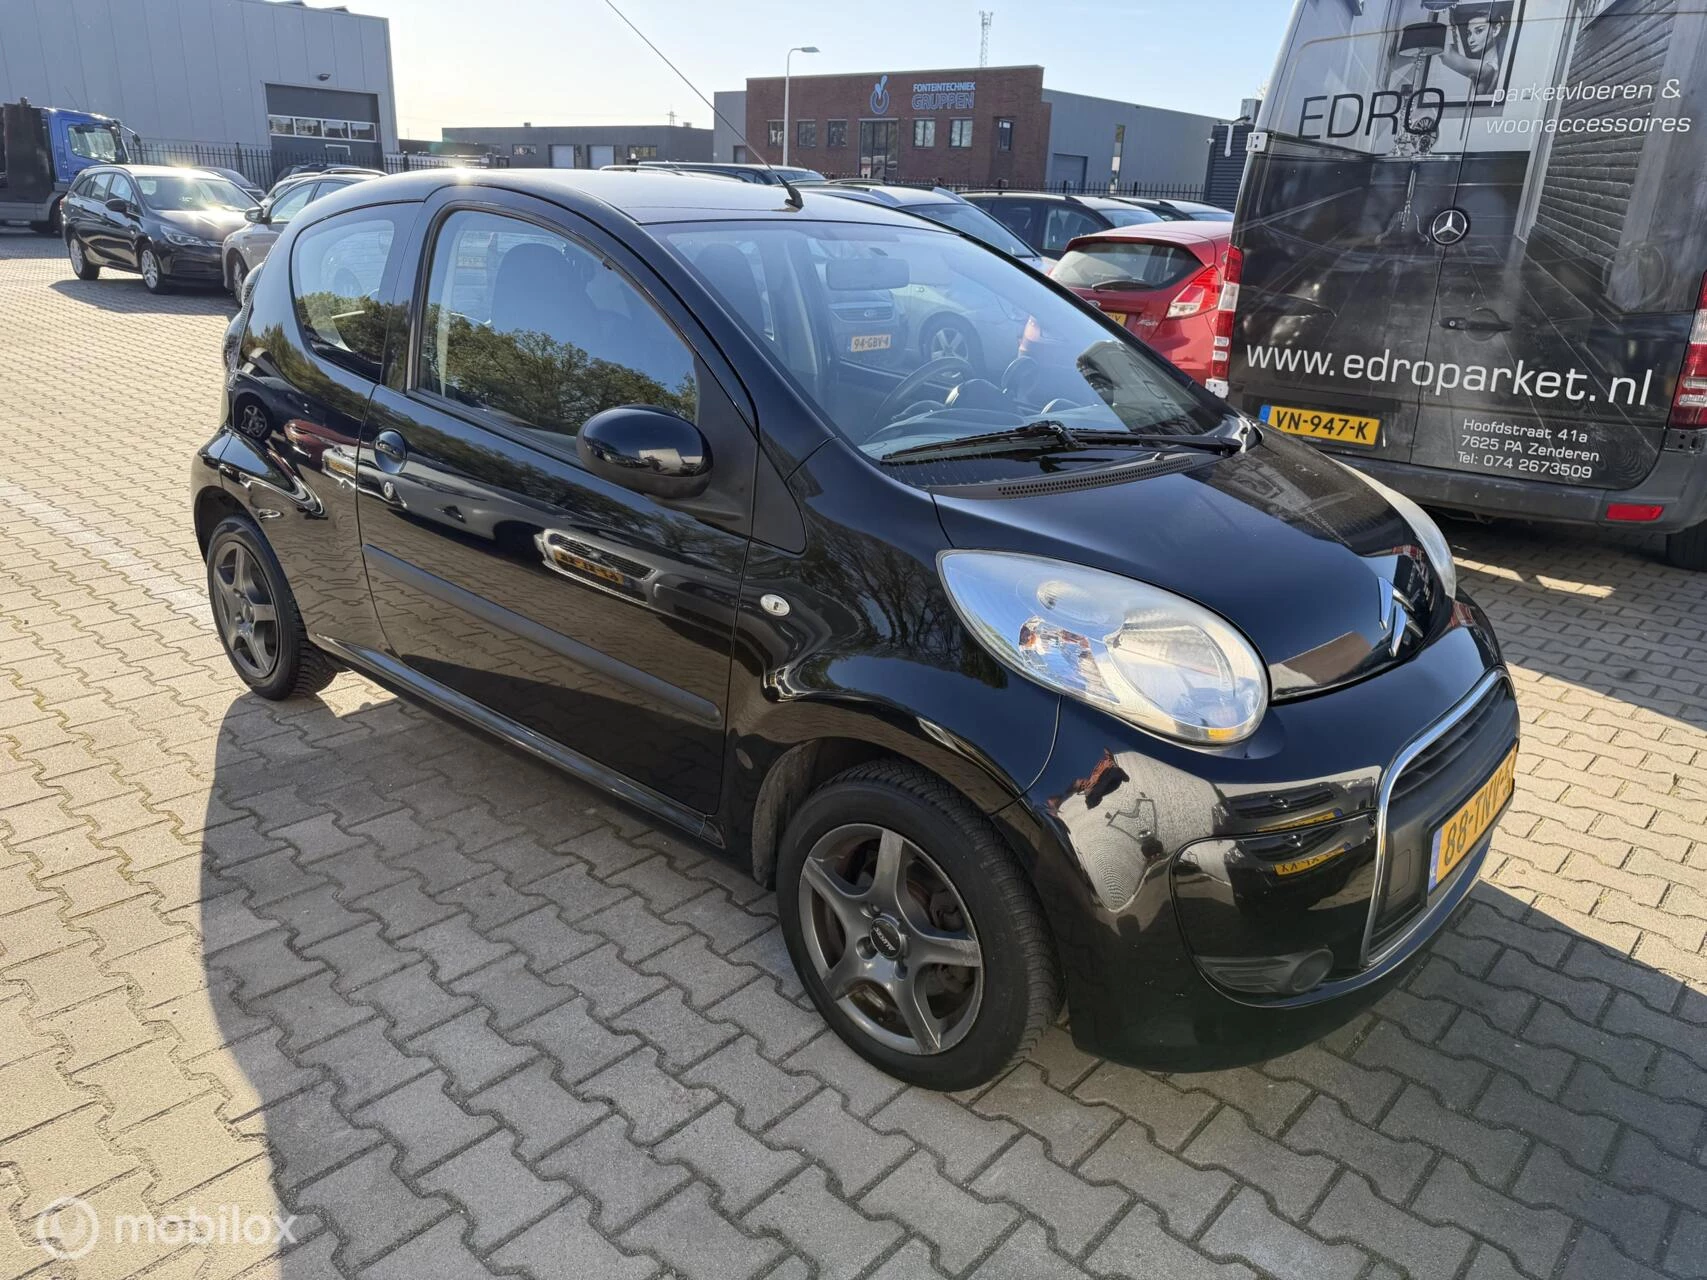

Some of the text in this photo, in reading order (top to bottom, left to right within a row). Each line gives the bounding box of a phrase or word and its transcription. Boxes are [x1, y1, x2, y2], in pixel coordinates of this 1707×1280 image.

[913, 81, 976, 92] FONTEINTECHNIEK
[1490, 78, 1681, 107] parketvloeren &
[912, 92, 975, 110] GRUPPEN
[1299, 87, 1445, 139] EDRO
[1486, 112, 1692, 135] woonaccessoires
[1246, 344, 1653, 406] www.edroparket.nl
[1276, 410, 1369, 440] VN-947-K
[1463, 418, 1588, 443] Hoofdstraat 41a
[1461, 435, 1600, 462] 7625 PA Zenderen
[1457, 451, 1593, 479] Tel: 074 2673509
